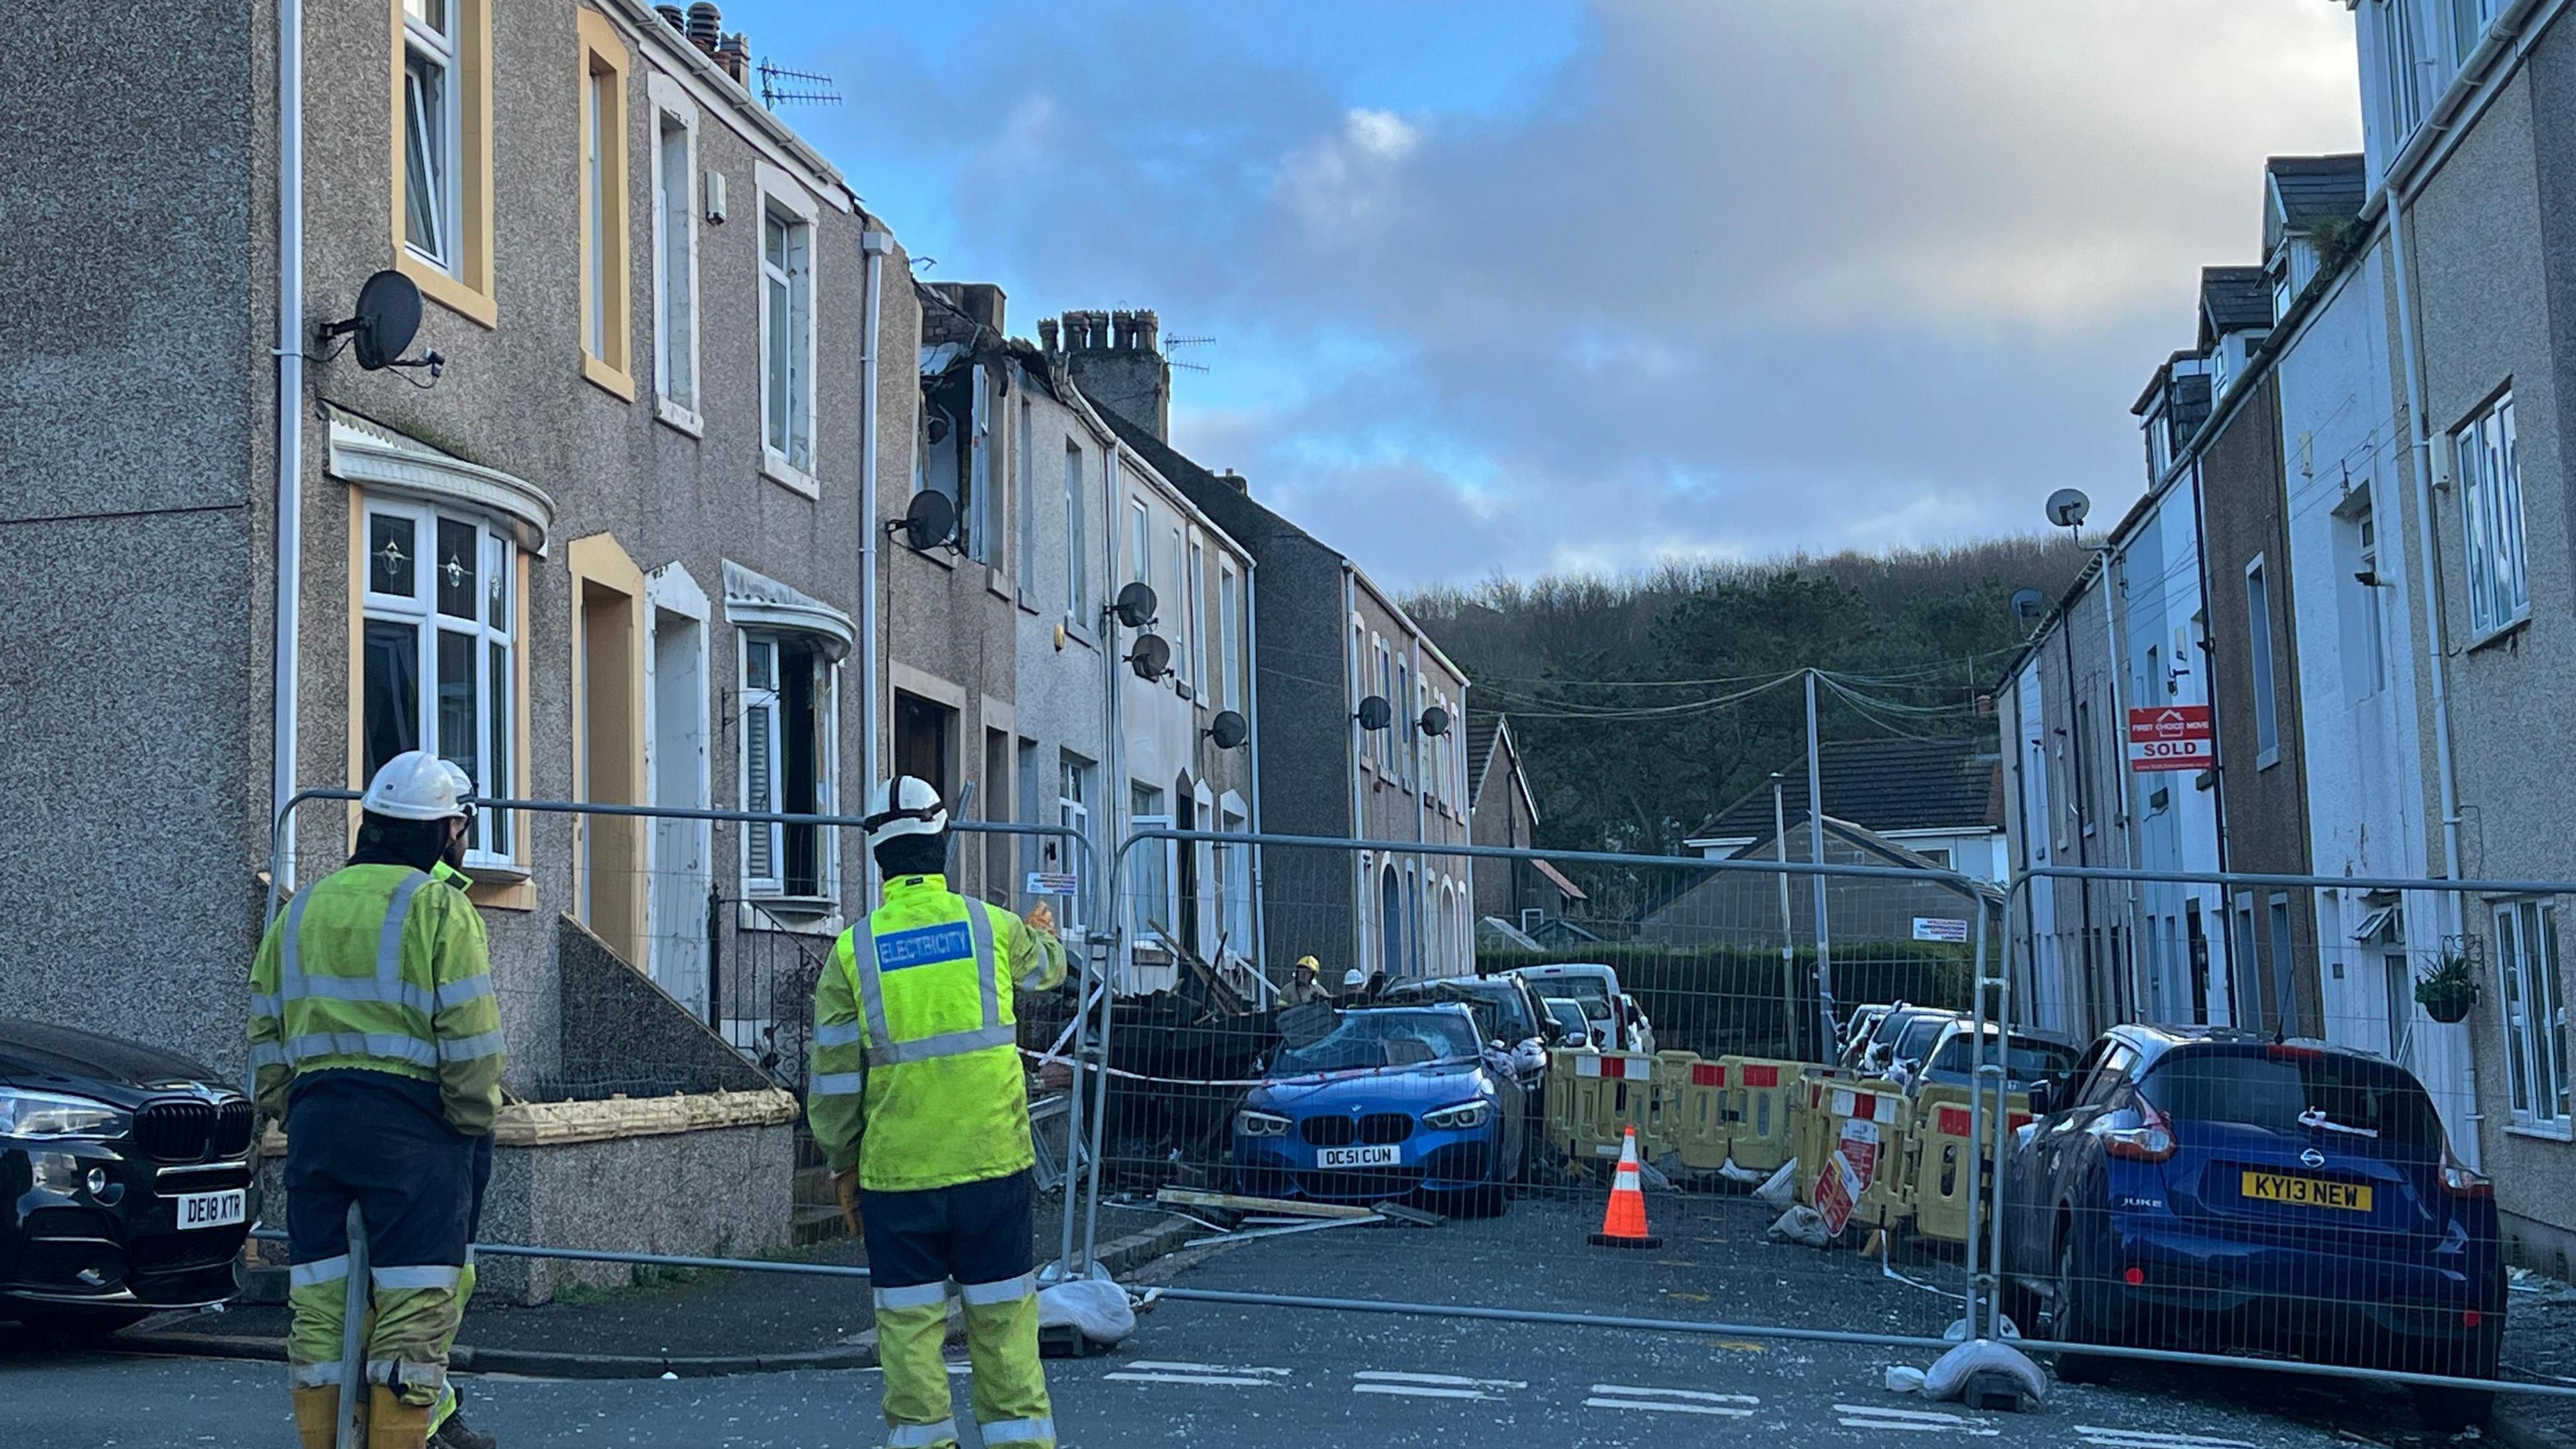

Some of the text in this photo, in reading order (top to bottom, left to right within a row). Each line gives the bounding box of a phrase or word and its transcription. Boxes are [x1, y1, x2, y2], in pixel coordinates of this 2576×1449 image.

[2132, 721, 2209, 732] FIRST CHOICE MOVE
[2144, 742, 2196, 757] SOLD
[879, 930, 967, 963] ELECTRICITY
[1362, 1148, 1391, 1163] CUN
[2255, 1175, 2357, 1207] KY13 NEW
[187, 1194, 240, 1223] DE18 XTR
[2121, 1197, 2163, 1208] JUKE
